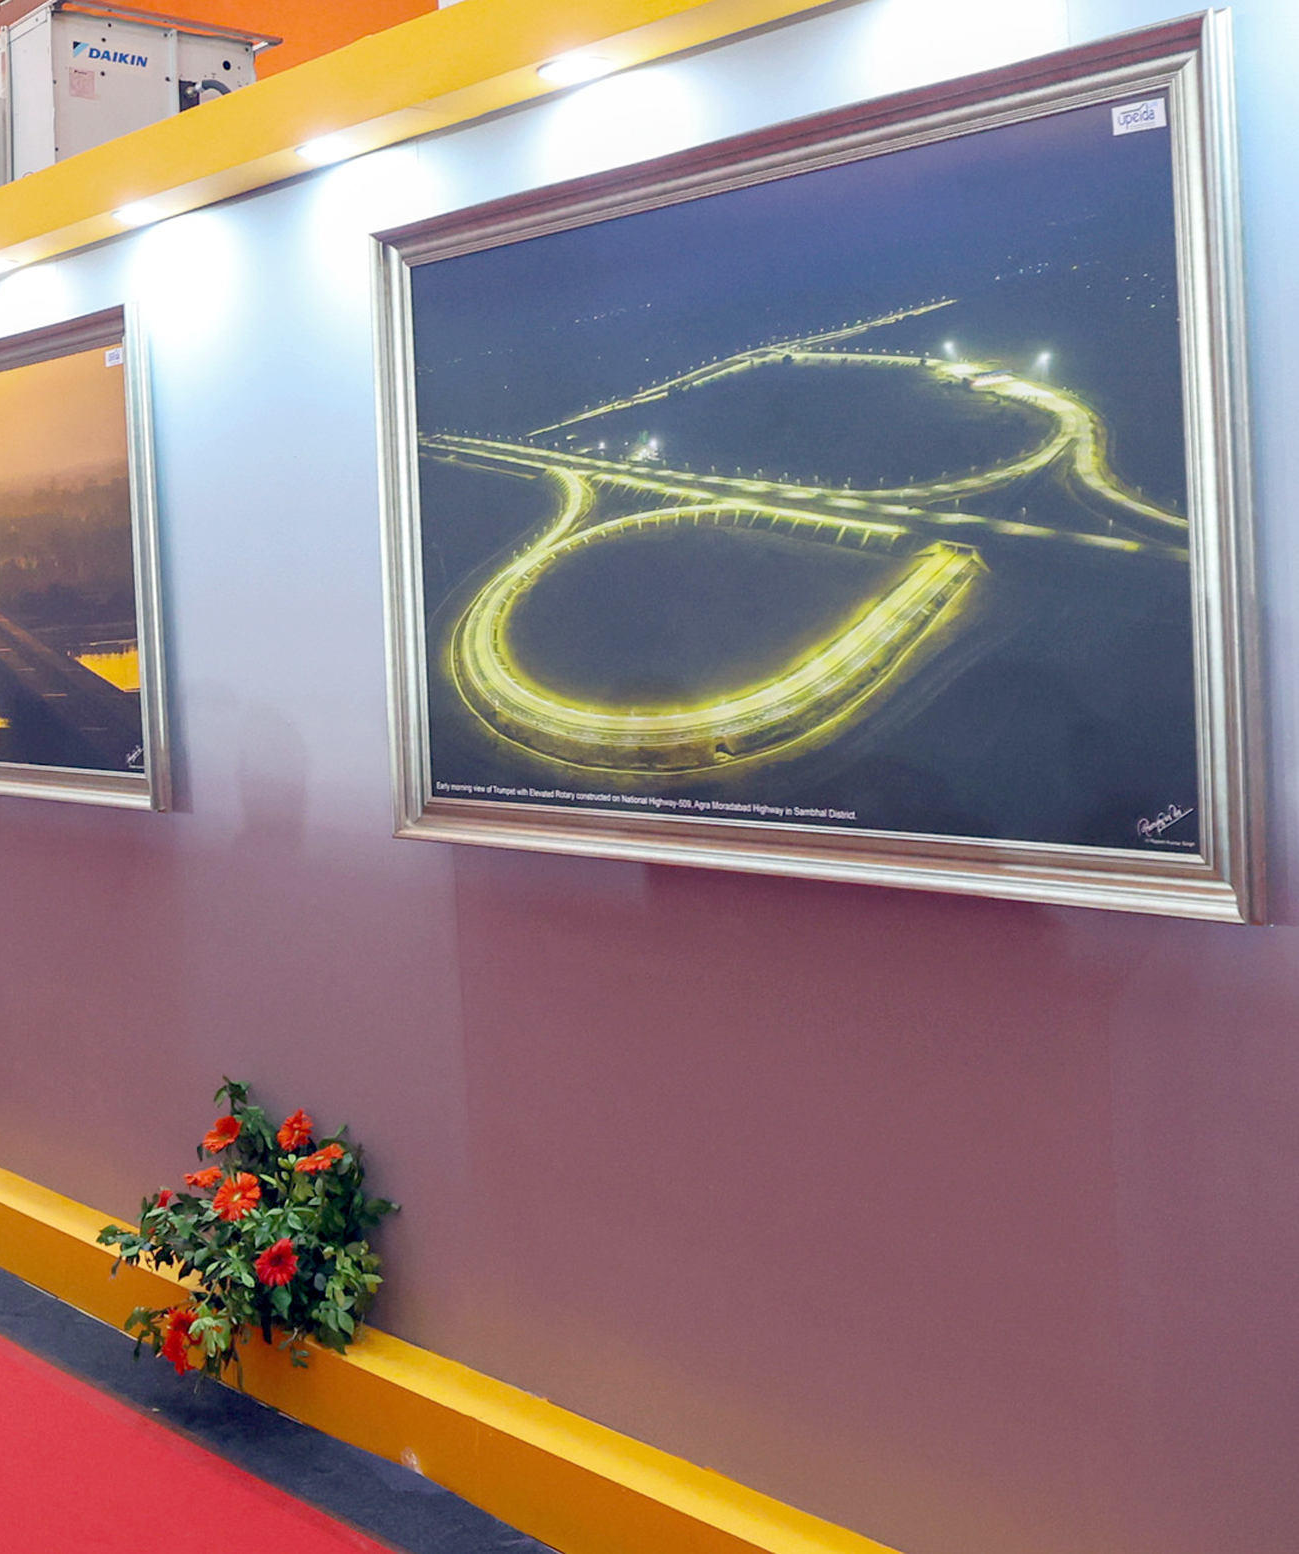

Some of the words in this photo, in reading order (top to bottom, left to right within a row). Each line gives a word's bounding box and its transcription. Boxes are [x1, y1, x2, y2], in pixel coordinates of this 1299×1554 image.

[88, 47, 148, 68] DAIKIN
[436, 782, 450, 791] Early
[529, 789, 554, 798] Elevated
[555, 790, 575, 801] Rotary
[576, 792, 611, 802] constructed
[621, 795, 648, 805] National
[694, 800, 711, 811] Agra
[711, 801, 751, 812] Moradabad
[752, 804, 784, 816] Highway
[785, 807, 792, 815] in
[793, 806, 827, 817] Sambhal
